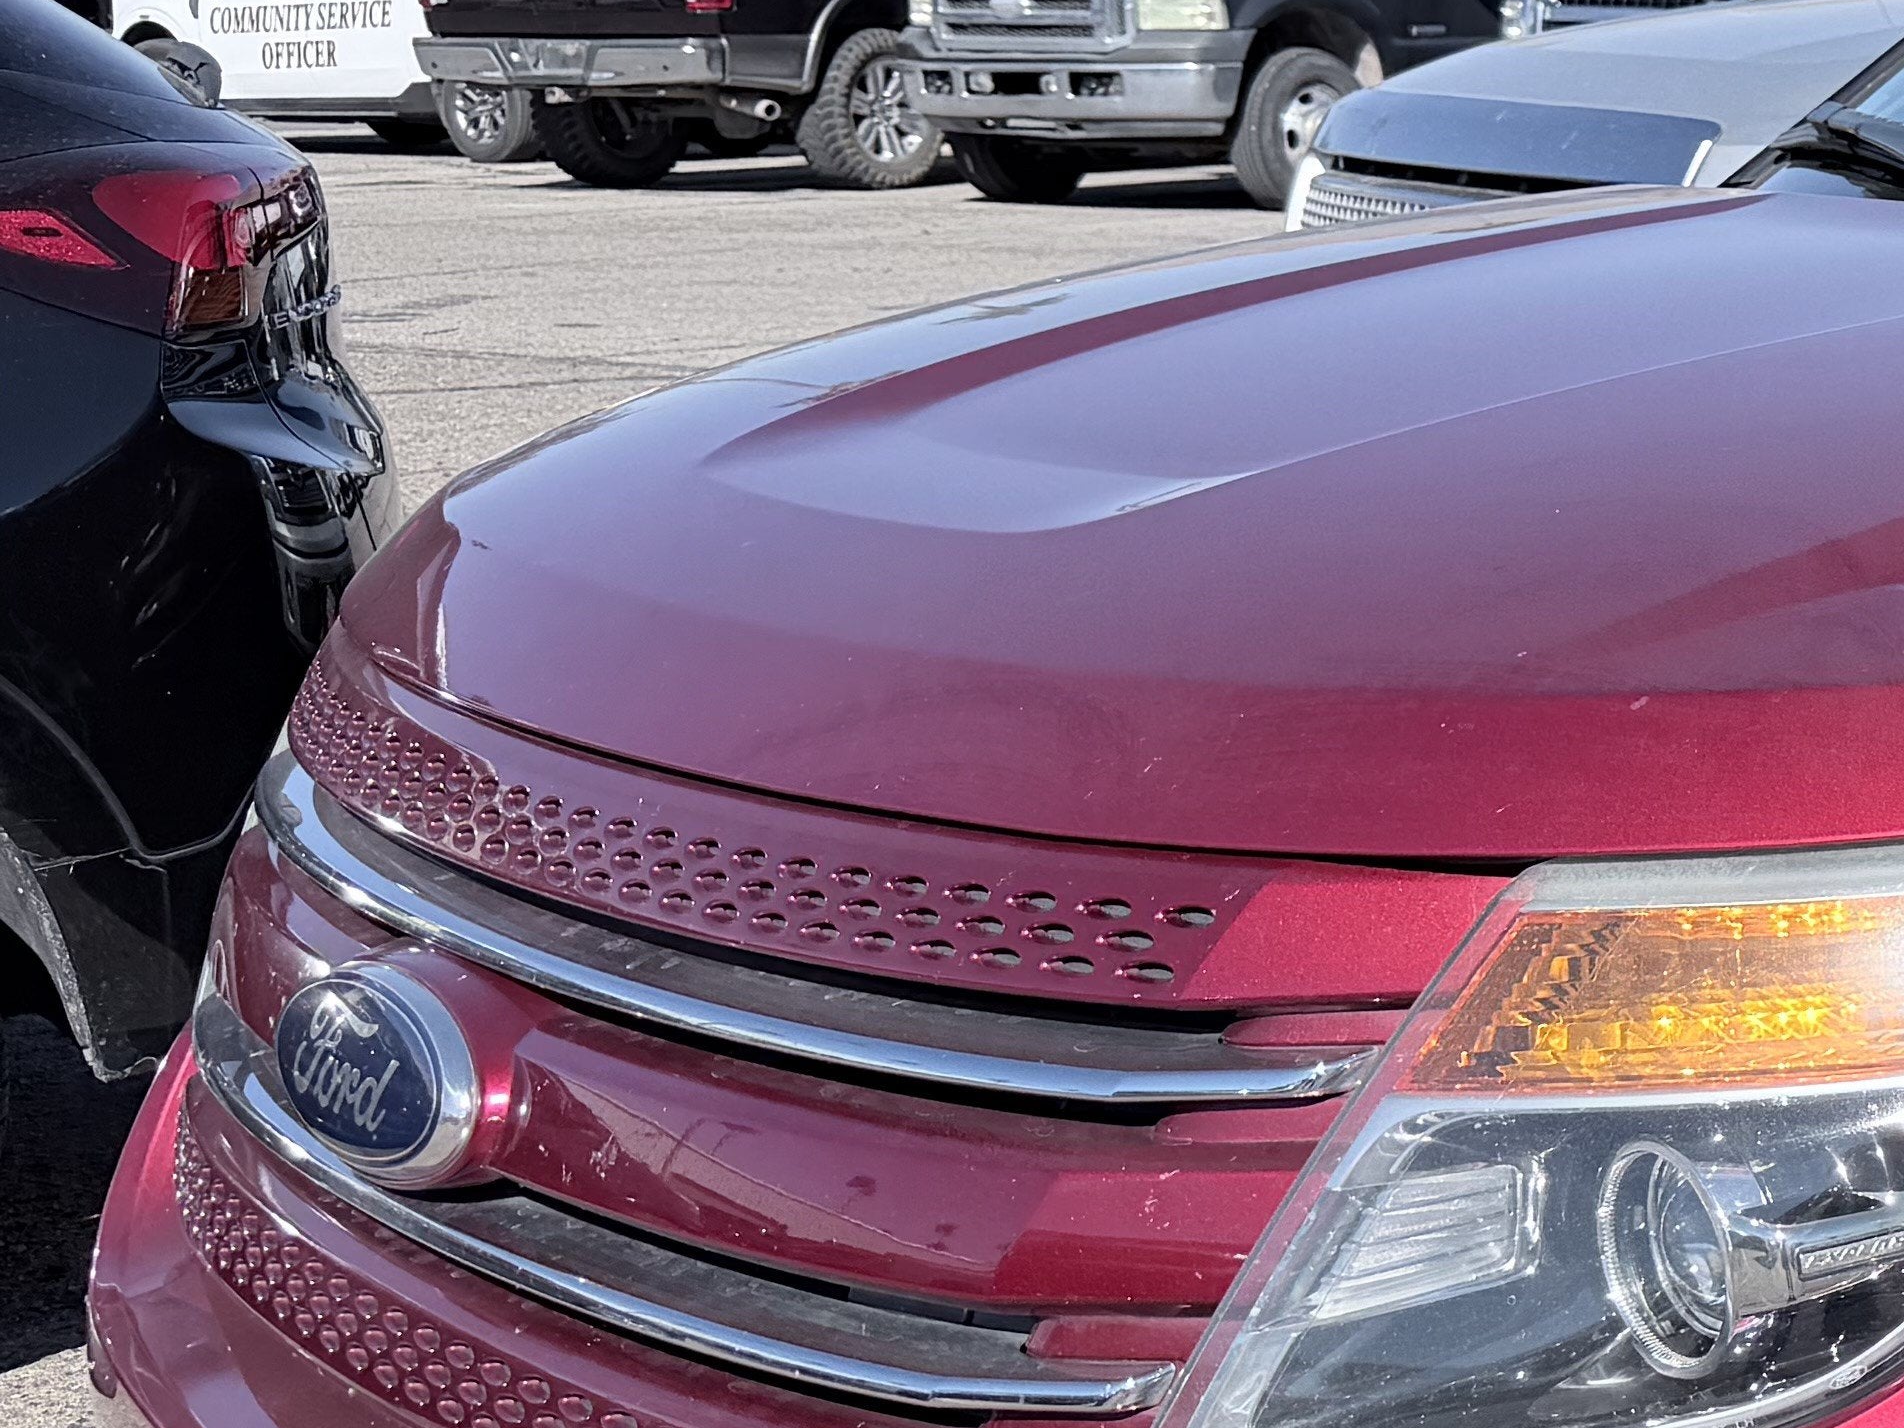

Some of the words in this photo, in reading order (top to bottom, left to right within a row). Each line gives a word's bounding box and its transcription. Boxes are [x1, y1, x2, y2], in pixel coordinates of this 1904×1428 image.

[210, 3, 313, 35] COMMUNITY
[316, 0, 392, 30] SERVICE
[262, 40, 337, 70] OFFICER
[293, 990, 400, 1132] Ford
